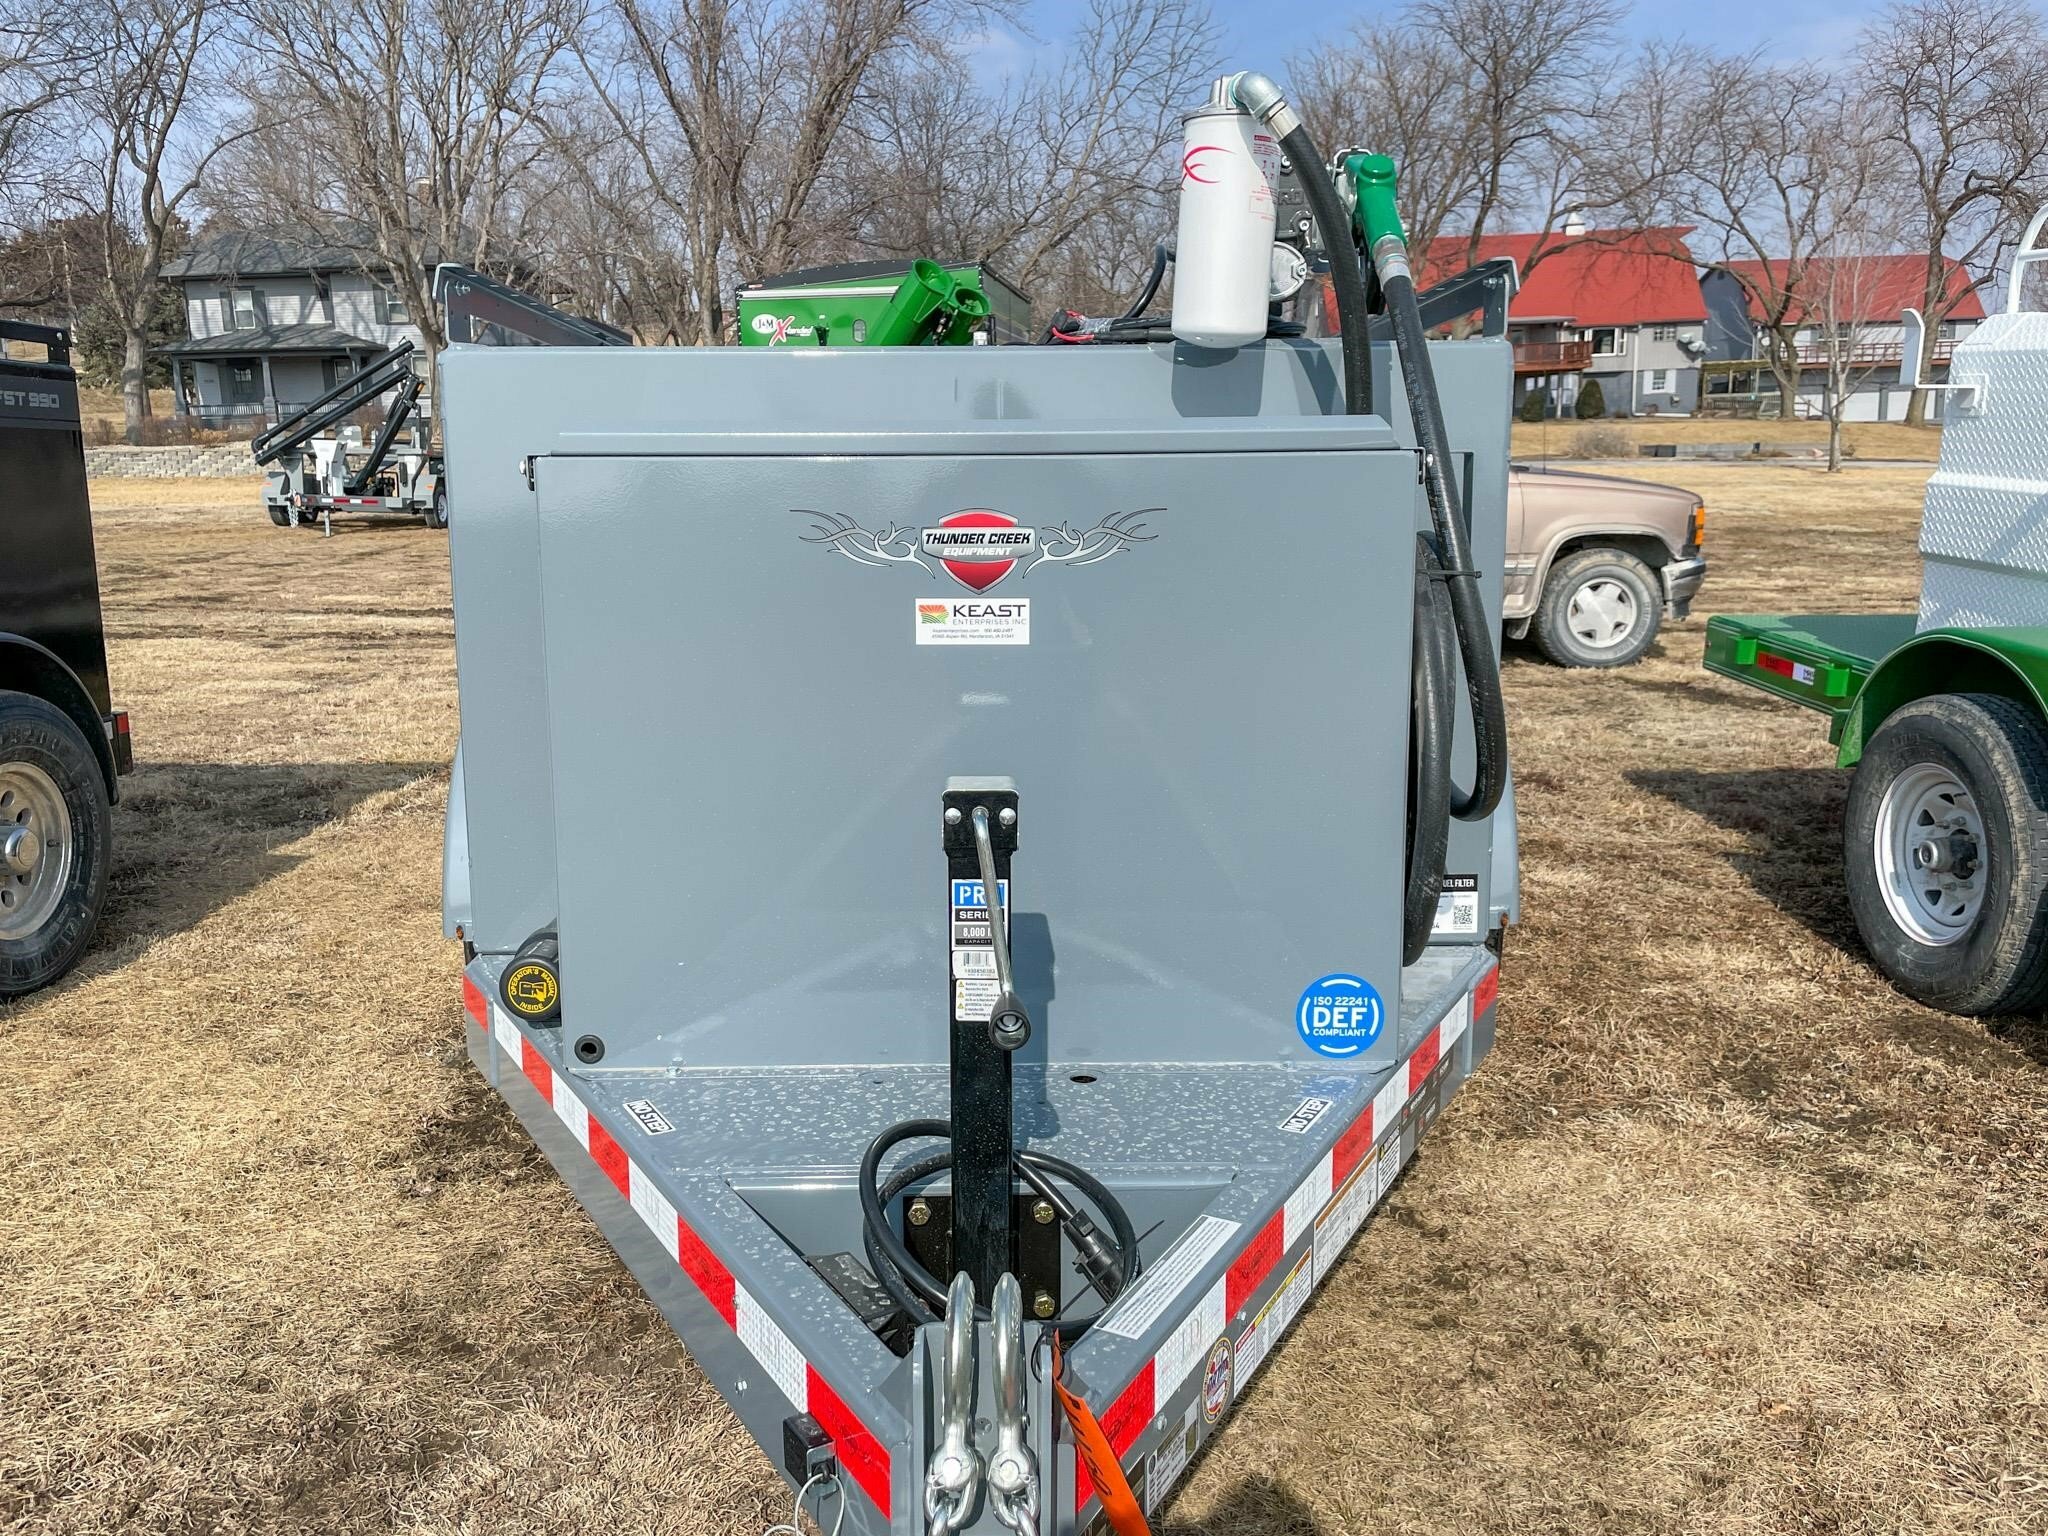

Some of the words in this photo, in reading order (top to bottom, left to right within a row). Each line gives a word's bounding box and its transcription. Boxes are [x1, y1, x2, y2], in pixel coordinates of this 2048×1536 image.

[0, 390, 26, 406] ST
[28, 392, 60, 409] 990
[925, 532, 986, 545] THUNDER
[988, 532, 1032, 545] CREEK
[942, 547, 1014, 557] EQUIPMENT
[952, 604, 1027, 618] KEAST
[952, 618, 1010, 626] ENTERPRISES
[1011, 618, 1027, 626] INC
[1442, 878, 1454, 888] UEL
[1454, 878, 1475, 888] FILTER
[960, 886, 986, 904] PR
[959, 911, 990, 919] SERIE
[963, 927, 986, 938] 8,000
[510, 968, 539, 996] OPERATOR'S
[541, 972, 555, 997] MANUAL
[520, 1001, 544, 1011] INSIDE
[1313, 996, 1333, 1006] ISO
[1334, 996, 1369, 1007] 22241
[1312, 1006, 1368, 1029] DEF
[1312, 1028, 1367, 1037] COMPLIANT
[629, 1101, 653, 1114] NO
[1296, 1100, 1325, 1119] STEP
[640, 1112, 670, 1132] STEP
[1284, 1118, 1309, 1131] NO
